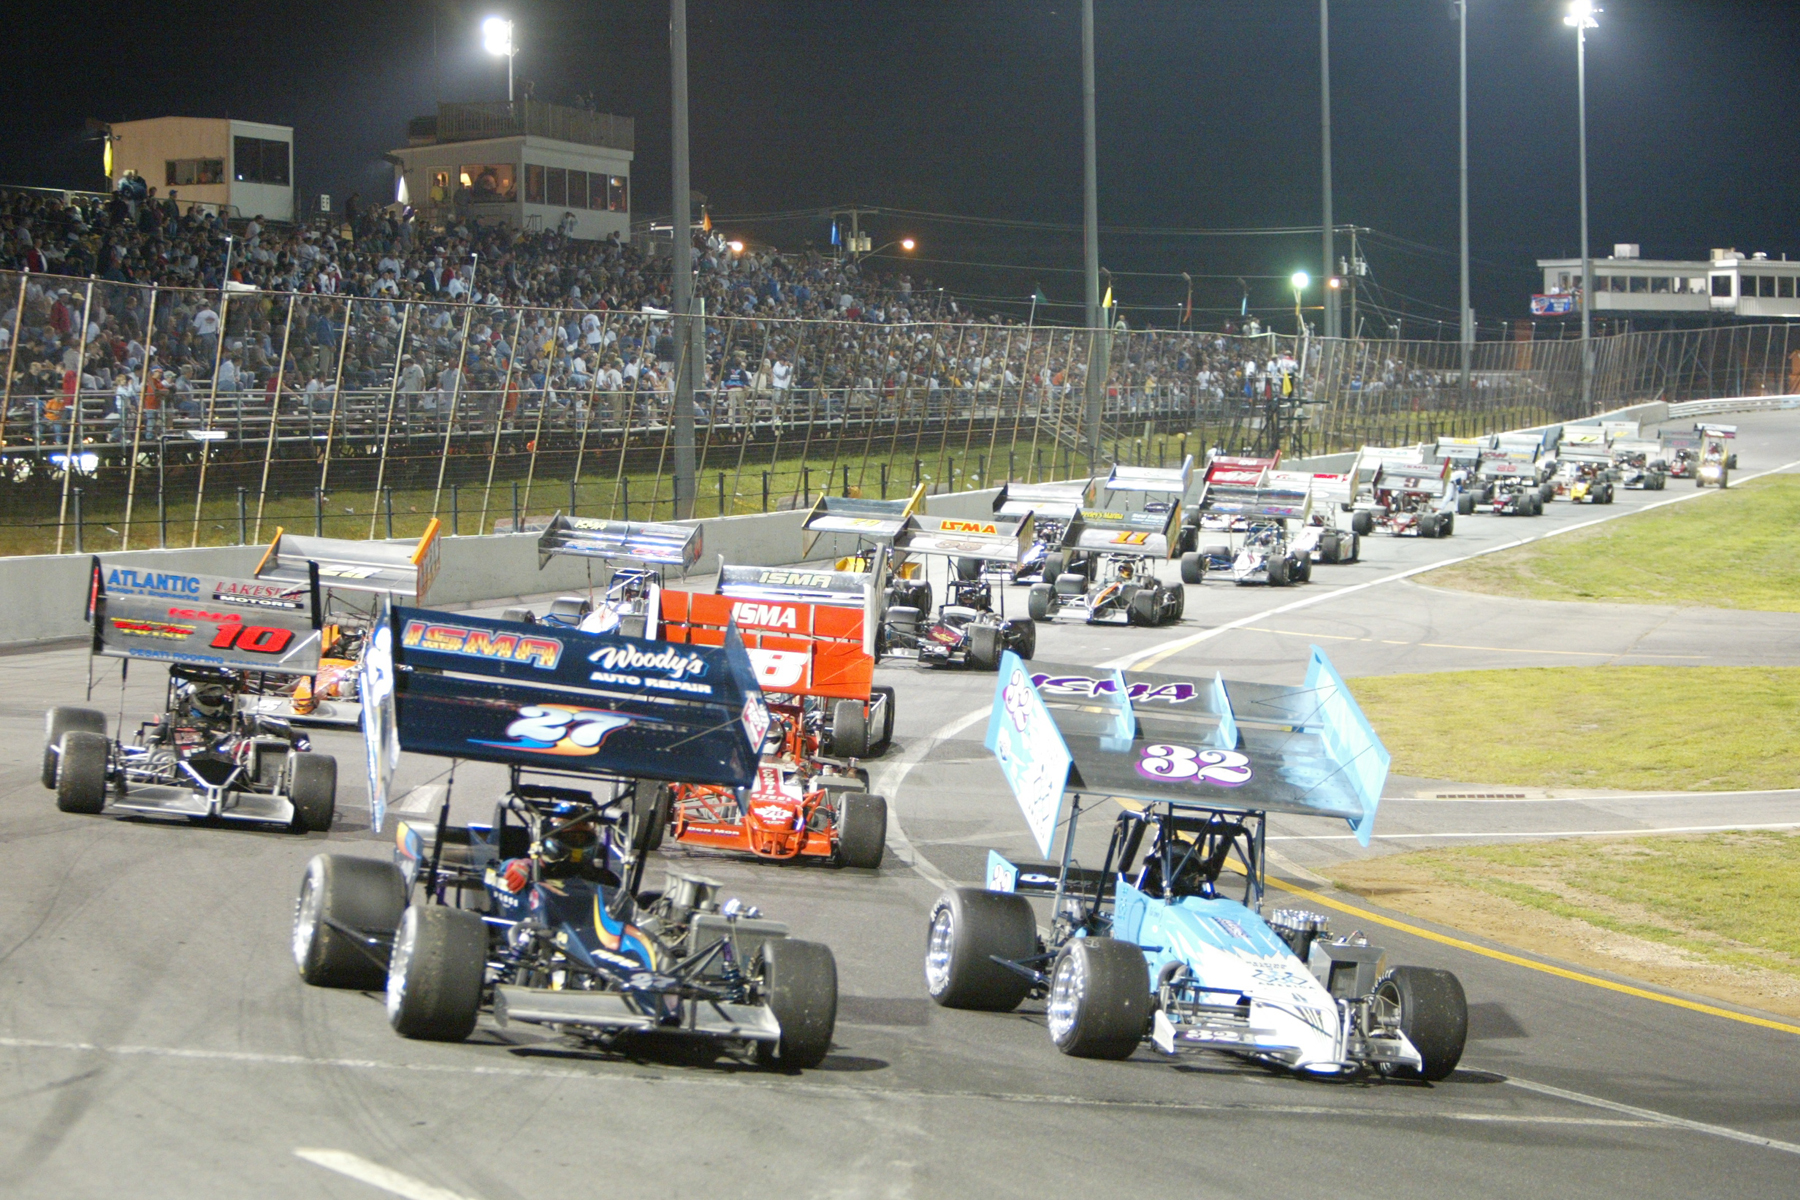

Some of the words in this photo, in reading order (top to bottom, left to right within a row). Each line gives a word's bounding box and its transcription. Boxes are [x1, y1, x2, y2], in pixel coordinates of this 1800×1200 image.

[941, 520, 997, 535] ISMA
[1109, 530, 1151, 546] 11
[107, 569, 200, 594] ATLANTIC
[759, 571, 832, 588] ISMA
[220, 595, 297, 608] MOTORS
[732, 602, 797, 629] ISMA
[210, 623, 295, 654] 10
[402, 619, 563, 670] ISMA
[588, 643, 707, 680] Woody's
[589, 670, 642, 687] AUTO
[644, 677, 713, 695] REPAIR
[506, 704, 632, 748] 27
[1136, 743, 1255, 788] 32
[1185, 1029, 1240, 1042] 32
